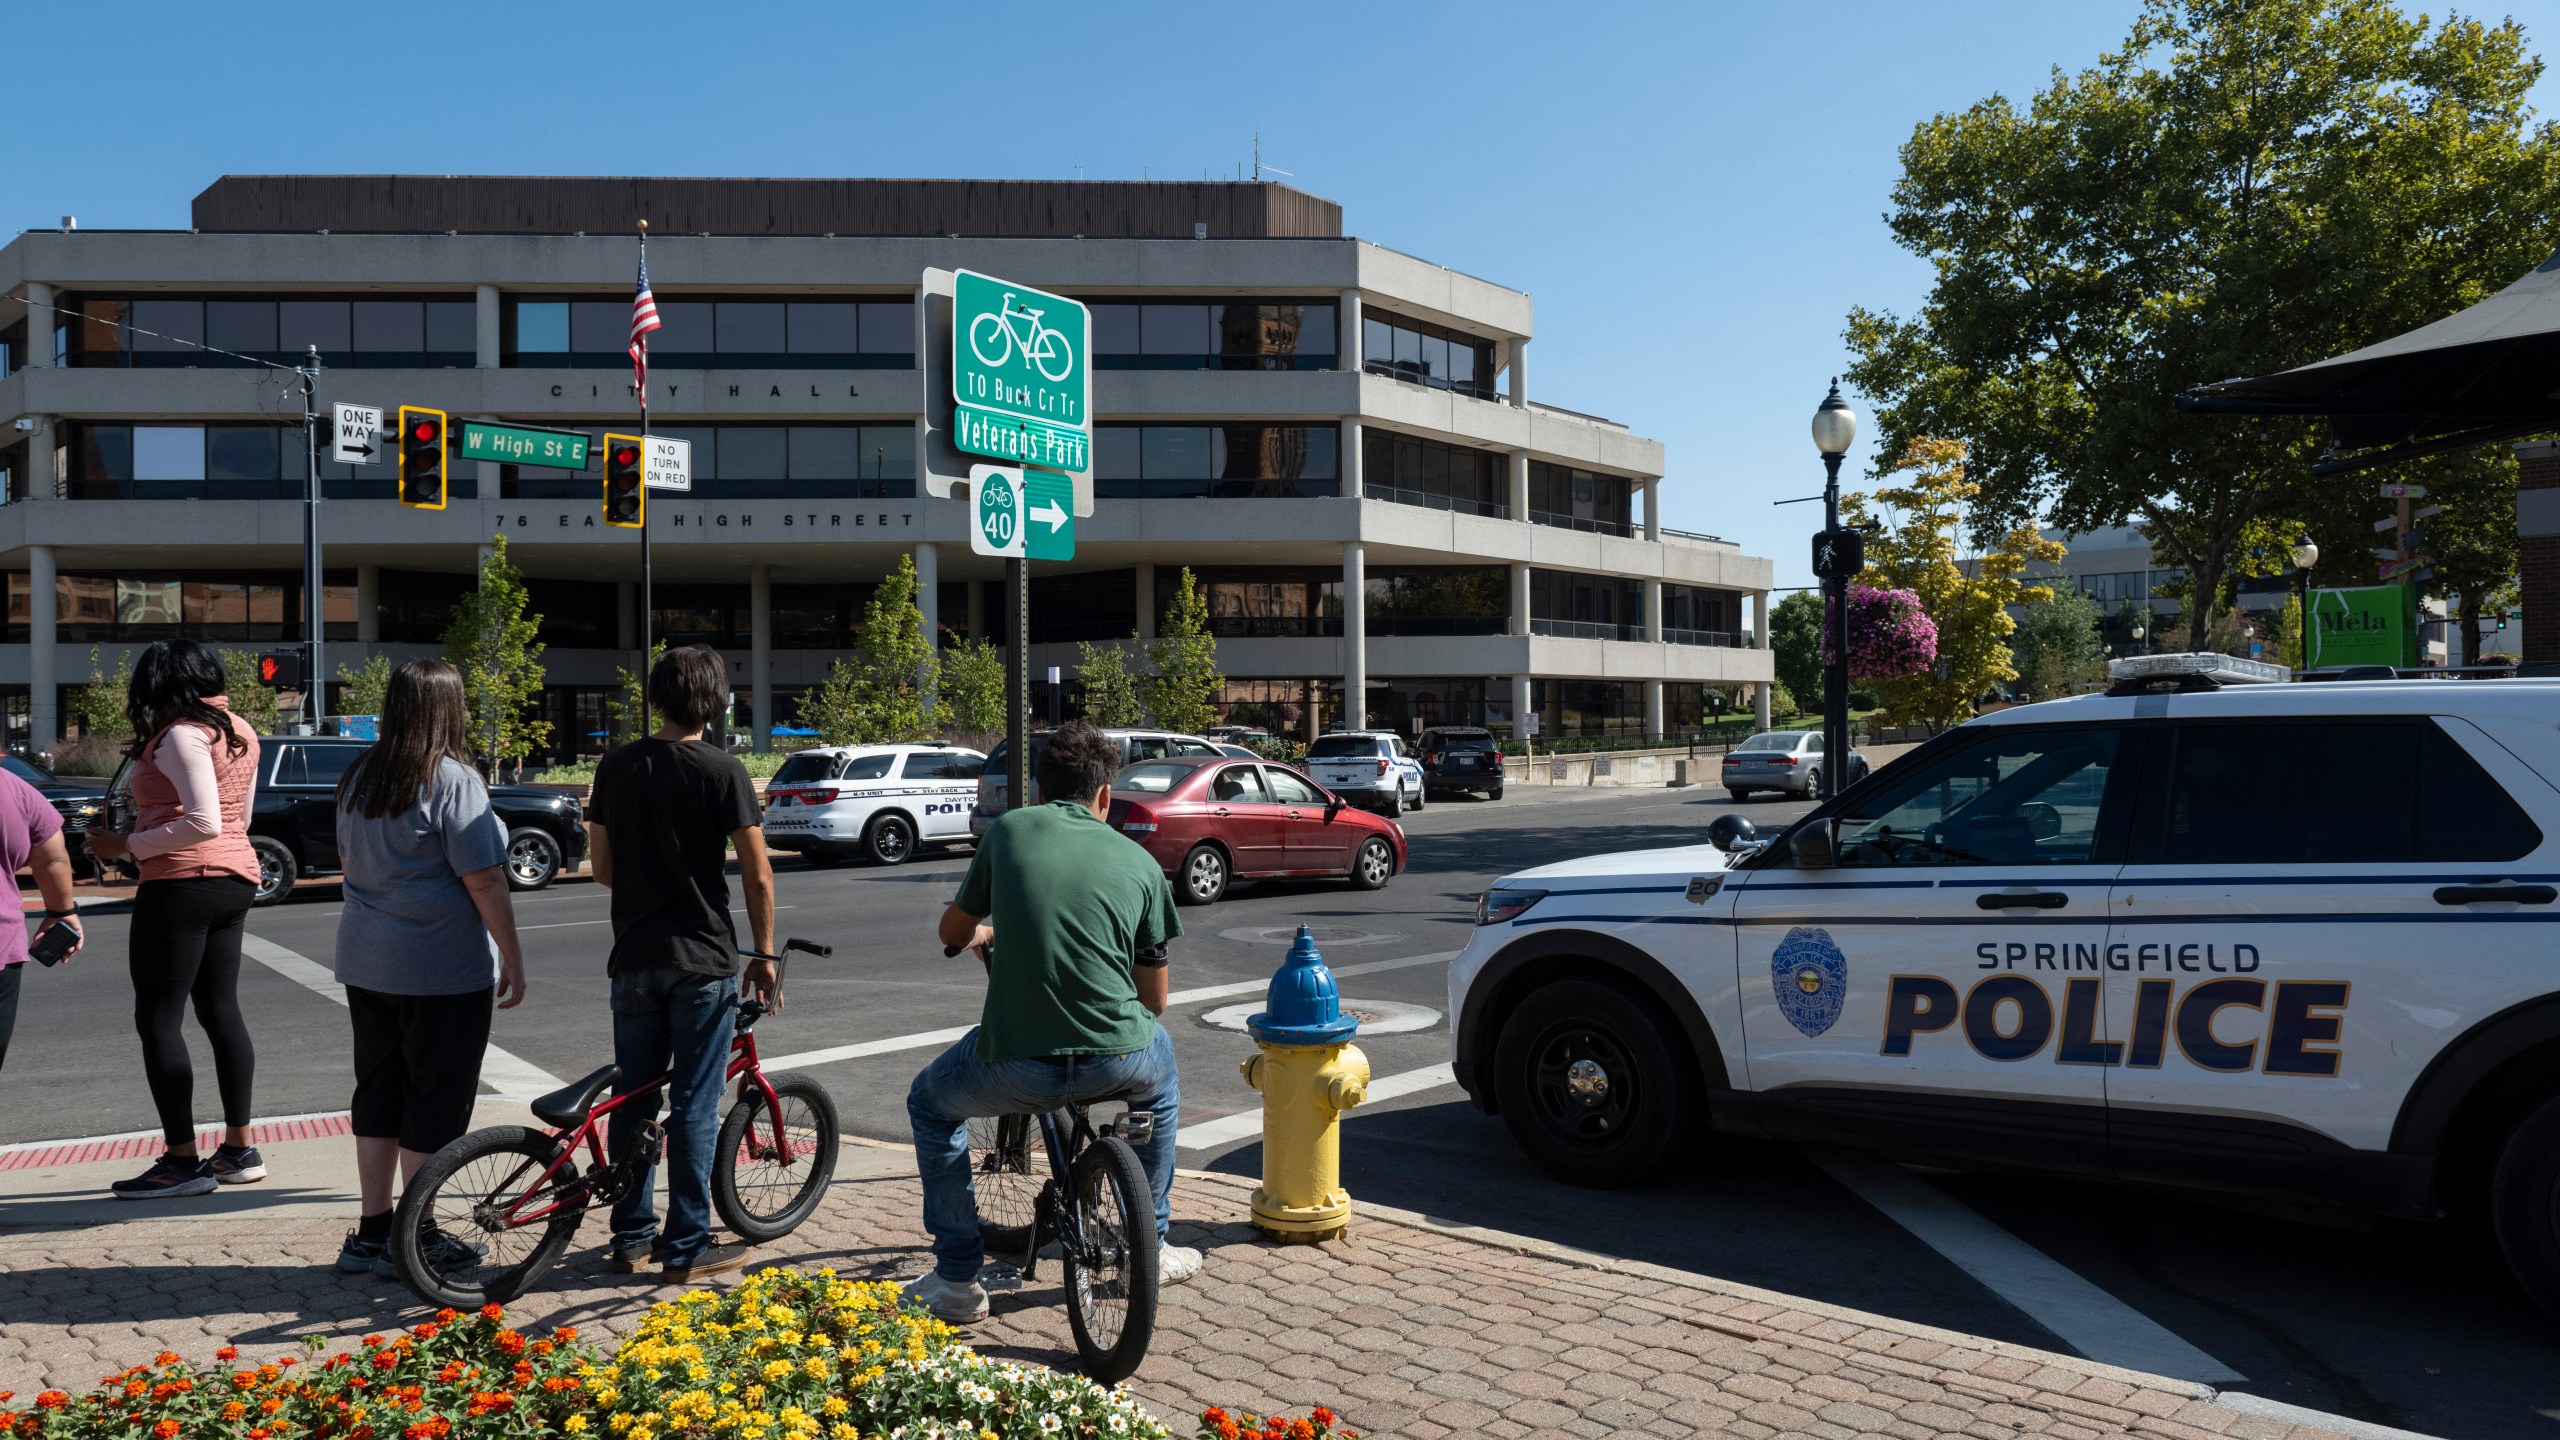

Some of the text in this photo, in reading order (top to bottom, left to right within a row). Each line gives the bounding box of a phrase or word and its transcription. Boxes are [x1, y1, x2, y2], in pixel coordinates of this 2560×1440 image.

[551, 385, 859, 397] CITY HALL
[967, 371, 1075, 417] TO Buck Cr Tr
[343, 409, 374, 425] ONE
[342, 424, 375, 440] WAY
[960, 410, 1083, 468] Veterans Park
[468, 431, 583, 460] W High St E
[658, 444, 675, 455] NO
[652, 457, 680, 470] TURN
[647, 470, 686, 484] ON RED
[495, 515, 527, 527] 76
[674, 514, 752, 527] HIGH
[784, 514, 912, 527] STREET
[984, 511, 1012, 540] 40
[1403, 771, 1418, 782] POLICE
[925, 803, 974, 816] POLI
[1689, 881, 1719, 896] 20
[1779, 942, 1838, 960] SPRINGFIELD OHIO
[1977, 943, 2261, 973] SPRINGFIELD
[1789, 953, 1827, 966] POLICE
[1787, 987, 1831, 1006] DIVISION
[1880, 973, 2352, 1078] POLICE
